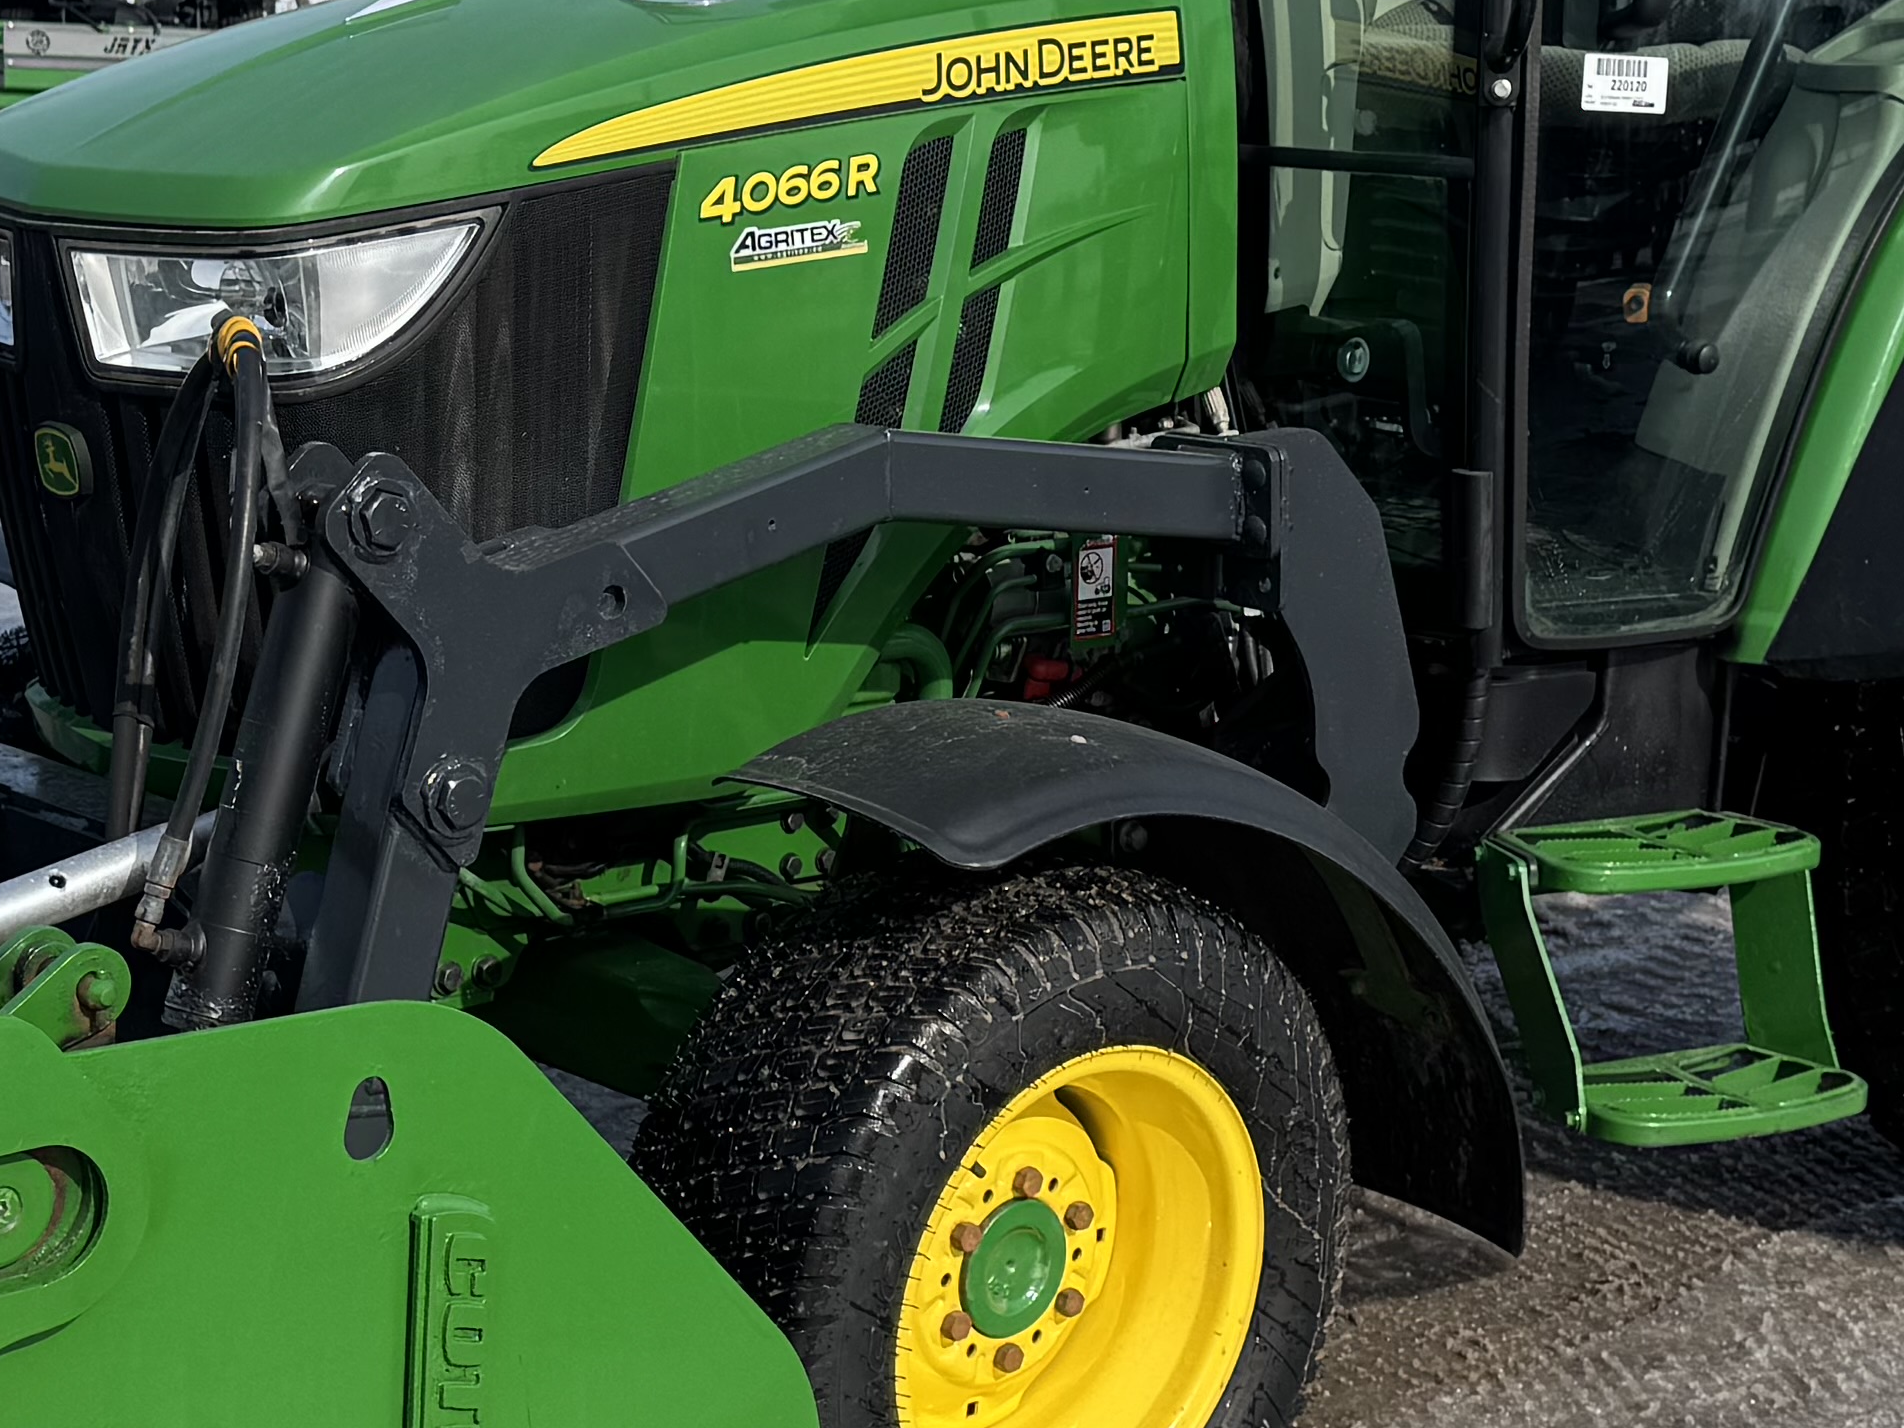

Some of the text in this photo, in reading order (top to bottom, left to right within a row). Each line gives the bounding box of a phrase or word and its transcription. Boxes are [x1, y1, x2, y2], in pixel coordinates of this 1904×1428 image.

[921, 34, 1155, 97] JOHN DEERE
[735, 224, 839, 254] AGRITEX
